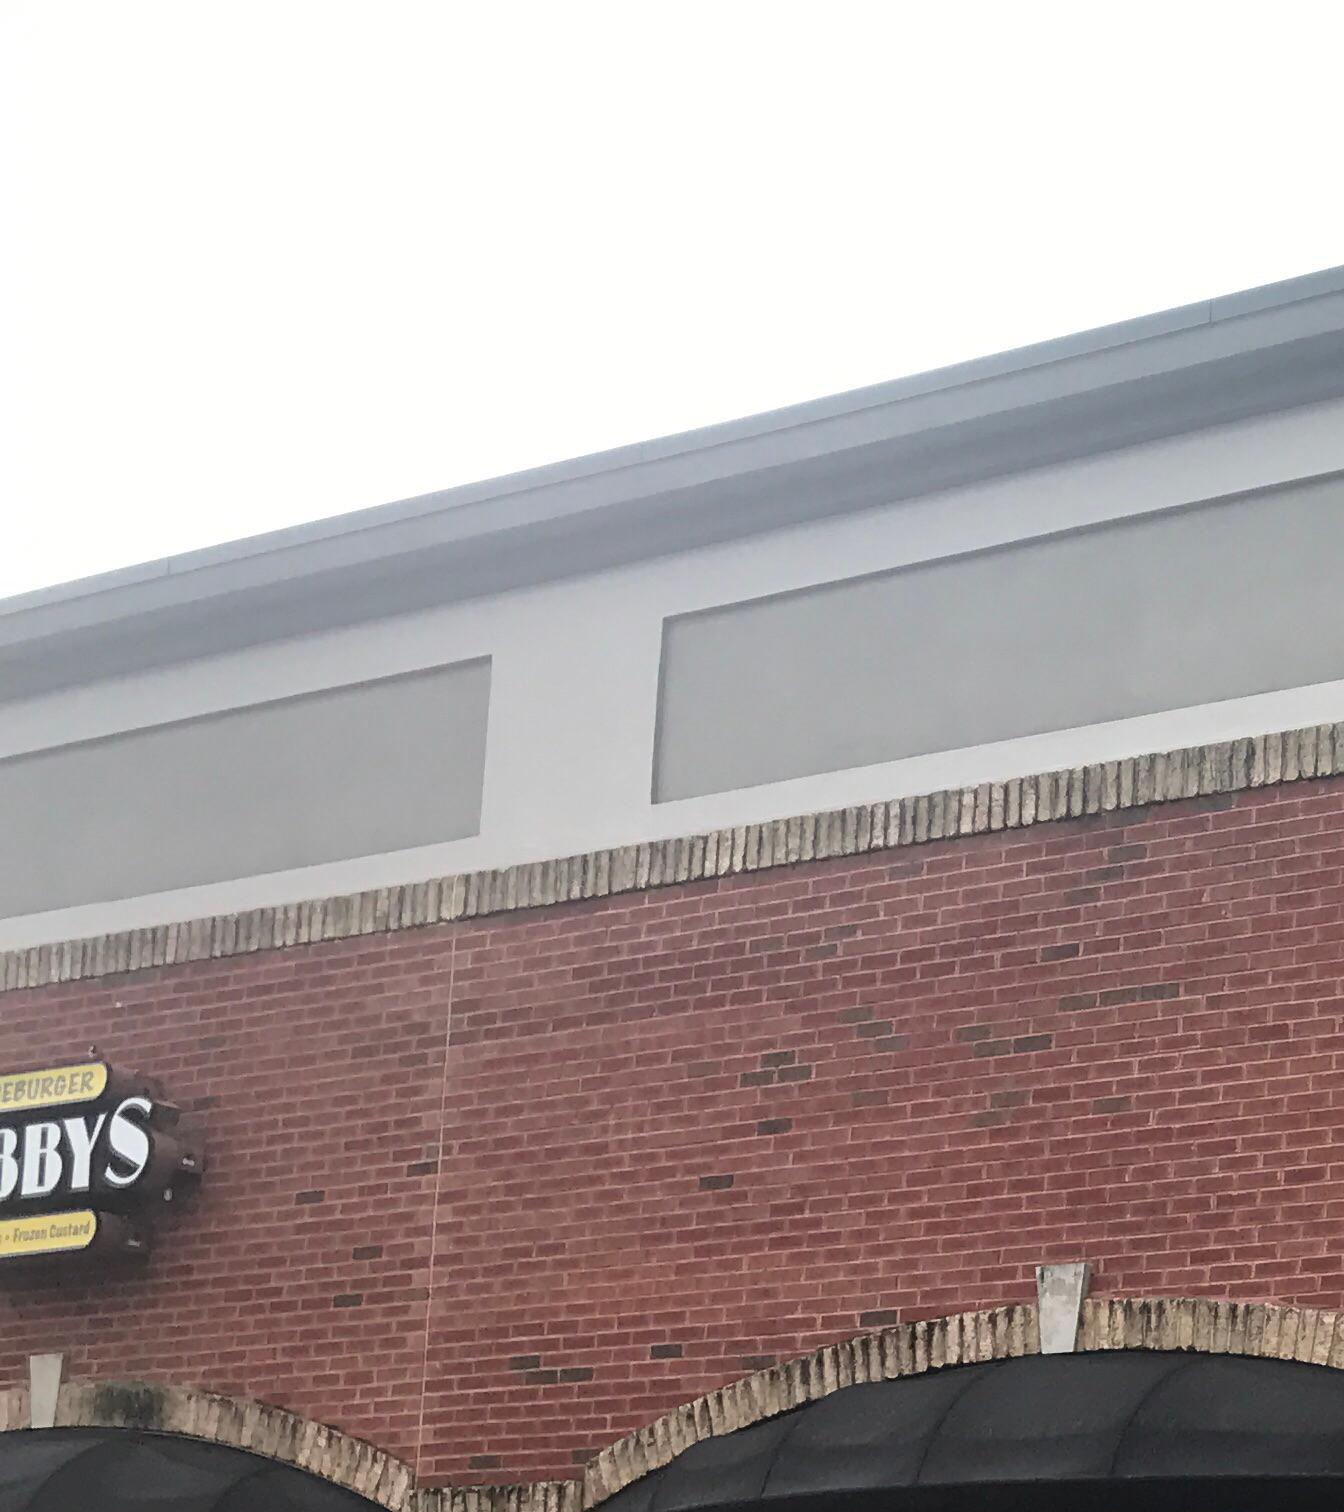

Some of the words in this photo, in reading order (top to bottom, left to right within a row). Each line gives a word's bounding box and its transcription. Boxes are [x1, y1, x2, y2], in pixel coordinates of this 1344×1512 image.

[0, 1071, 95, 1103] EBURGER
[13, 1227, 47, 1242] Frozen
[50, 1220, 90, 1238] Custard
